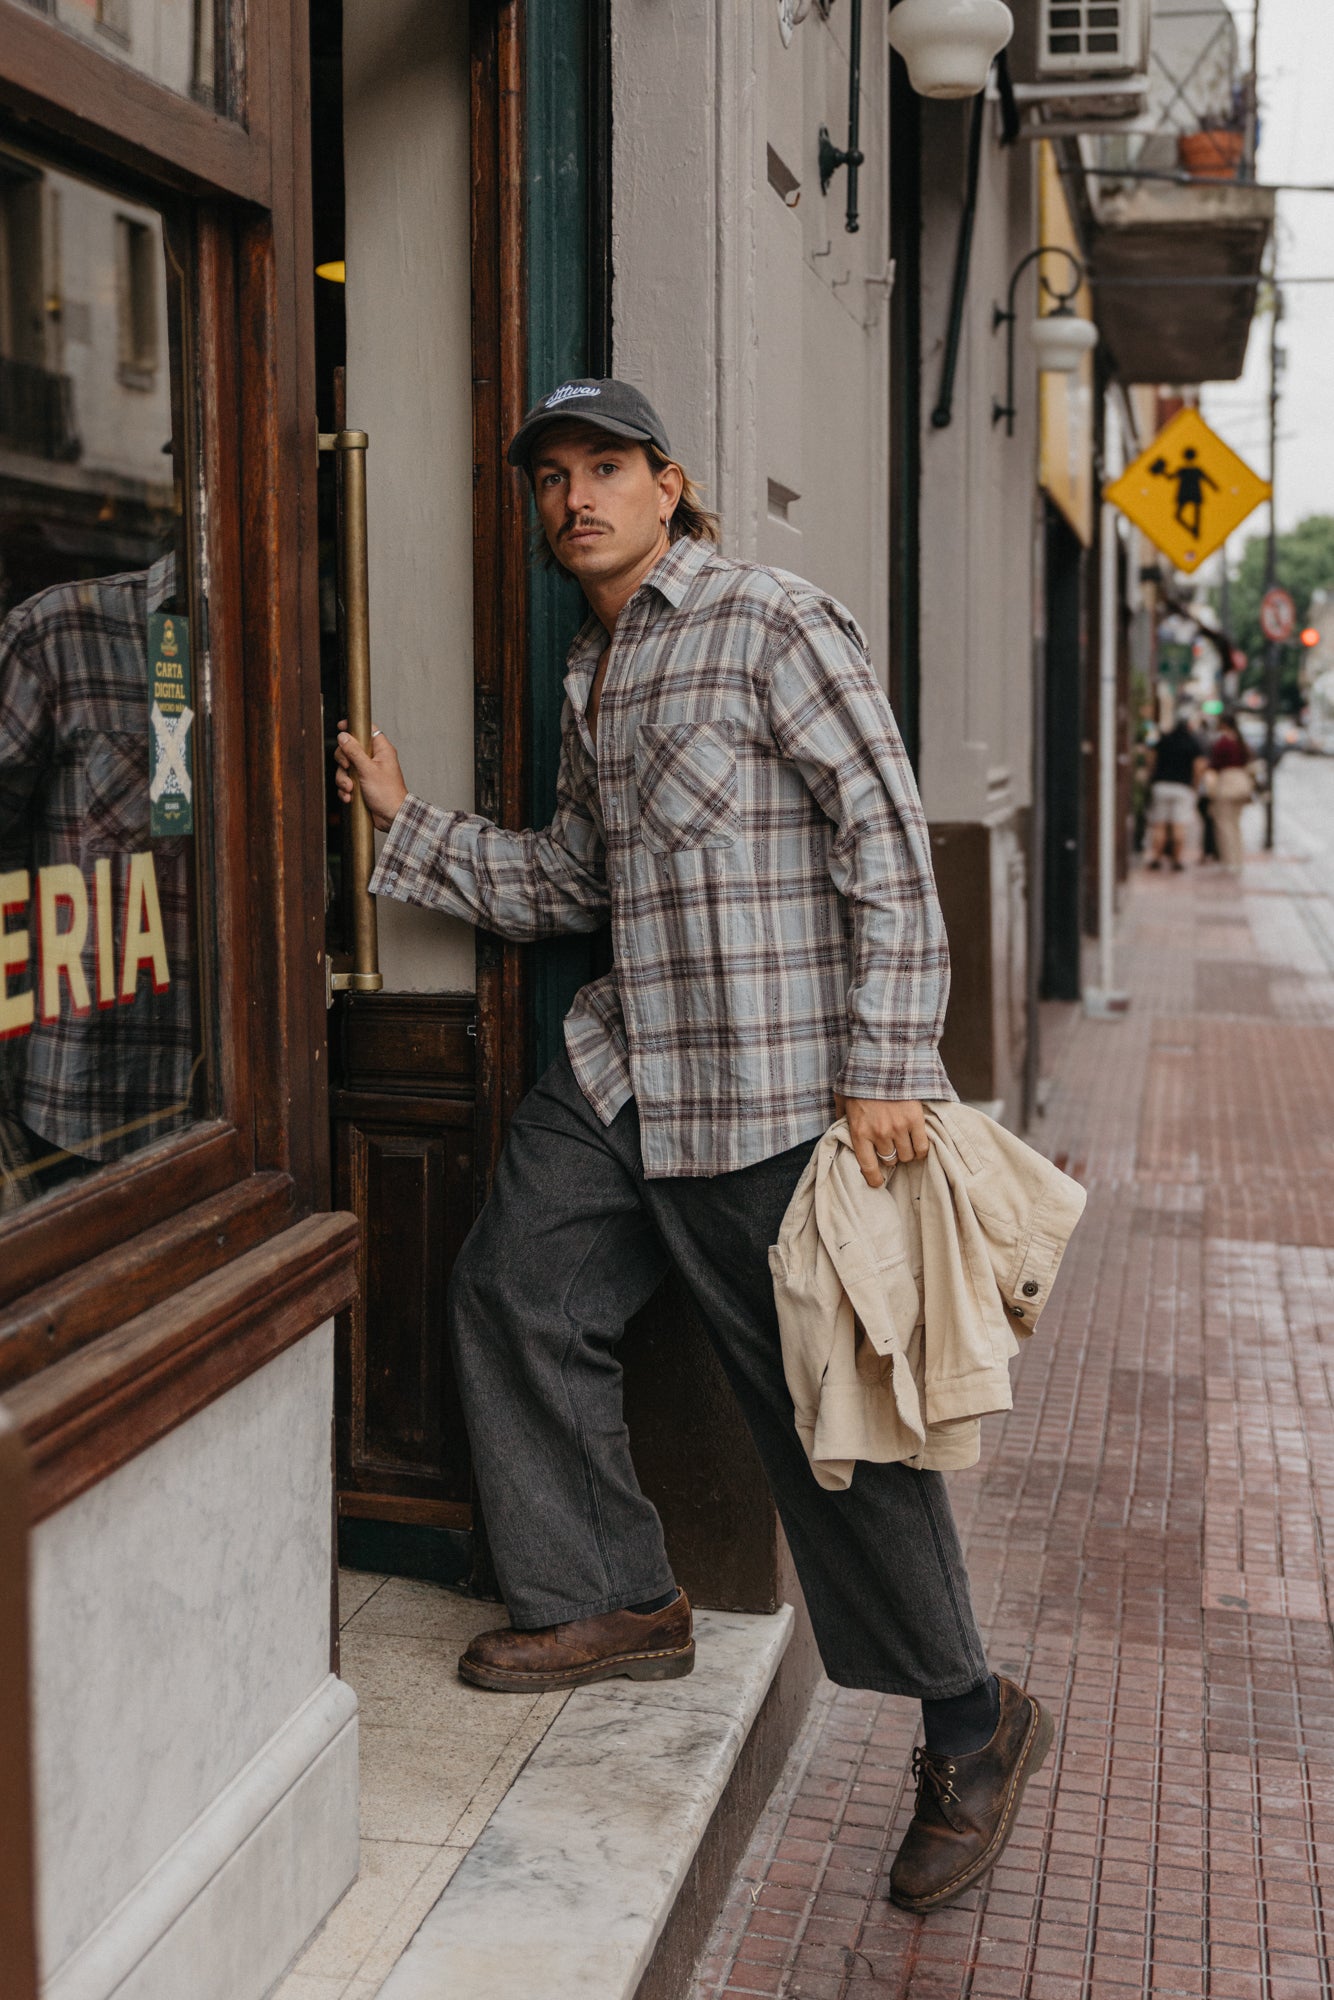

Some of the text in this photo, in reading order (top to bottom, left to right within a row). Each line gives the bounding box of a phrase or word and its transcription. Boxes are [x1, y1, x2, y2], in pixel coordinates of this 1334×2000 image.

[155, 661, 183, 679] CARTA
[154, 681, 186, 699] DIGITAL
[0, 851, 171, 1039] ERIA
